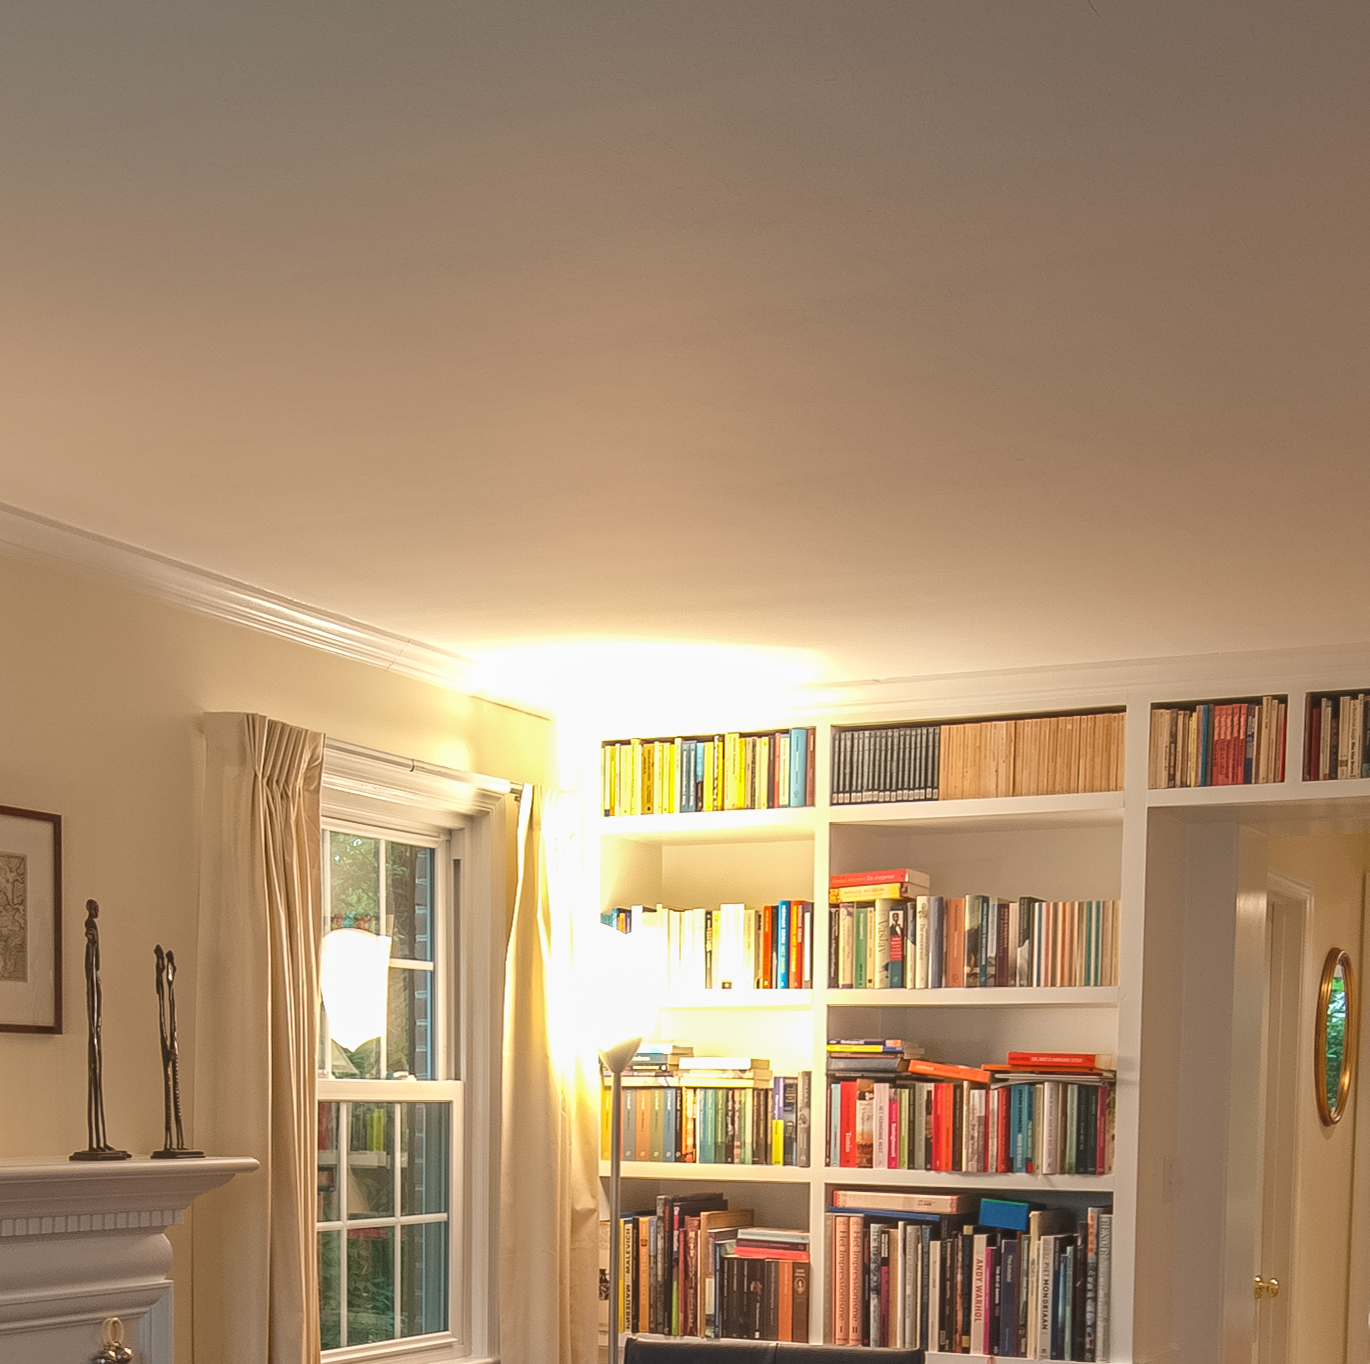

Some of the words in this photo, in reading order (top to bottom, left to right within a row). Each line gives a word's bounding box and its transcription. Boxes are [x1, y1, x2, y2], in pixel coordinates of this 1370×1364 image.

[878, 920, 889, 955] Vaslav
[839, 1231, 847, 1248] Het
[852, 1231, 861, 1248] Het
[838, 1250, 847, 1321] Impressionisme
[852, 1250, 861, 1322] Impressionisme
[975, 1259, 983, 1283] ANDY
[974, 1285, 983, 1323] WARHOL
[1042, 1279, 1050, 1330] MONDRIAAN
